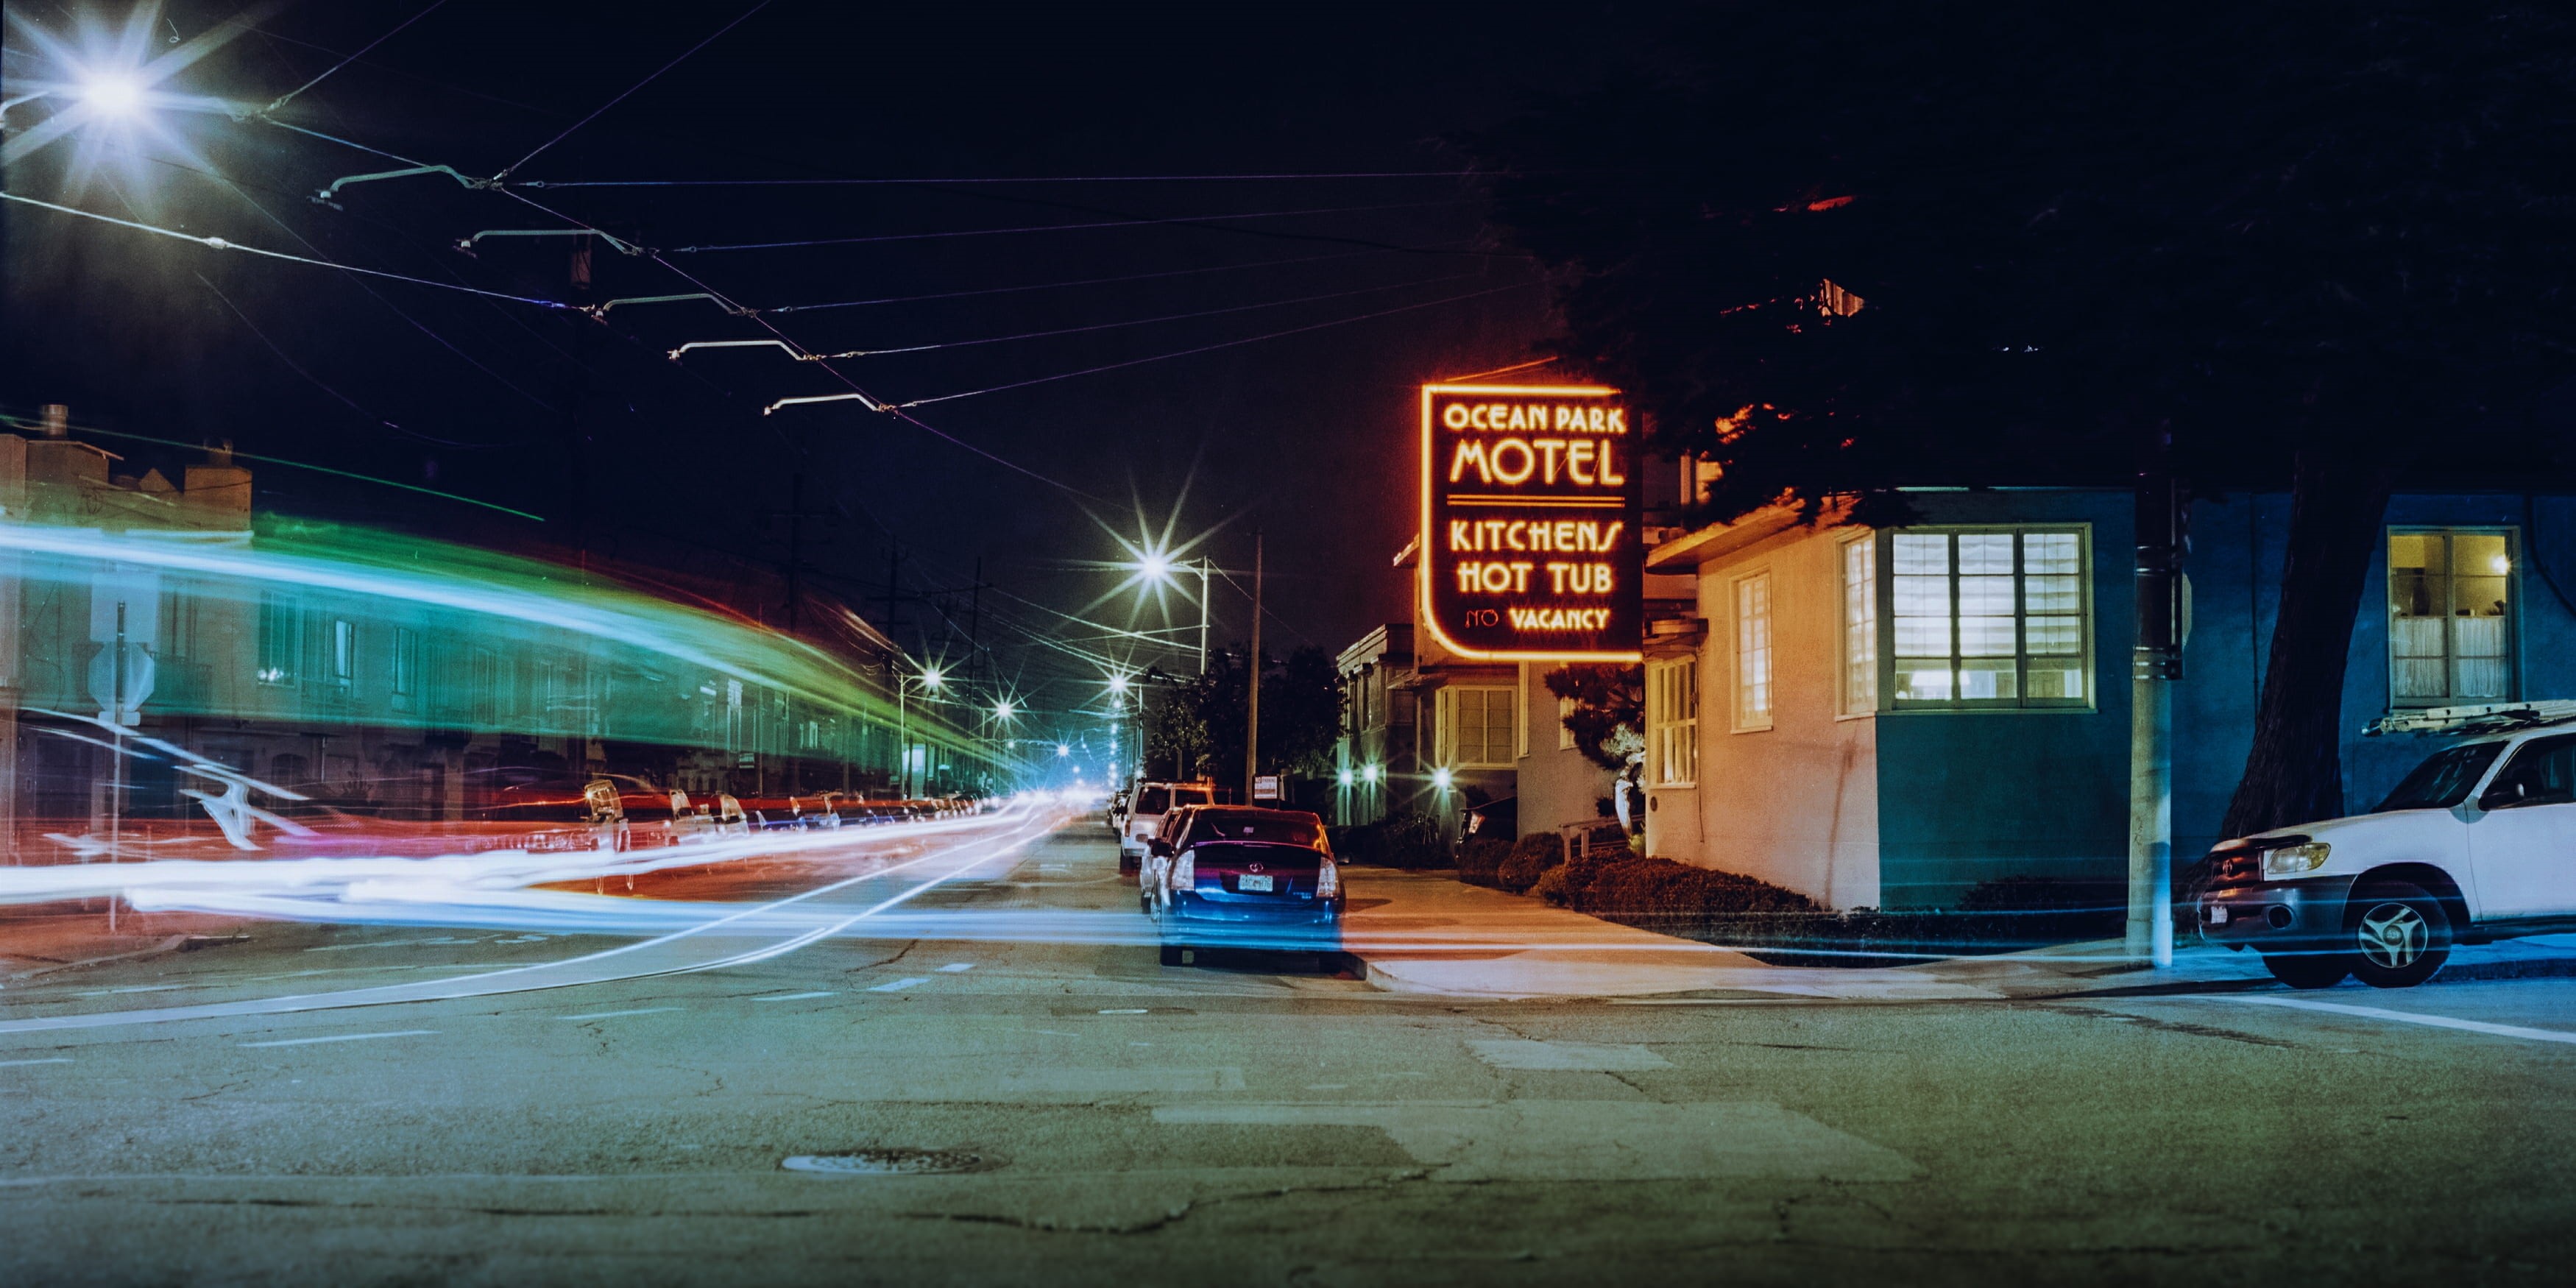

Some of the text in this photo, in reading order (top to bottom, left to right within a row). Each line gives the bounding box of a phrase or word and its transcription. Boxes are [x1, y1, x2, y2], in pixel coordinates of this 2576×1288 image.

[1443, 403, 1627, 434] OCEAN PARK
[1449, 437, 1624, 486] MOTEL
[1450, 520, 1623, 553] KITCHENS
[1457, 561, 1613, 595] HOT TUB
[1465, 607, 1610, 631] NO VACANCY
